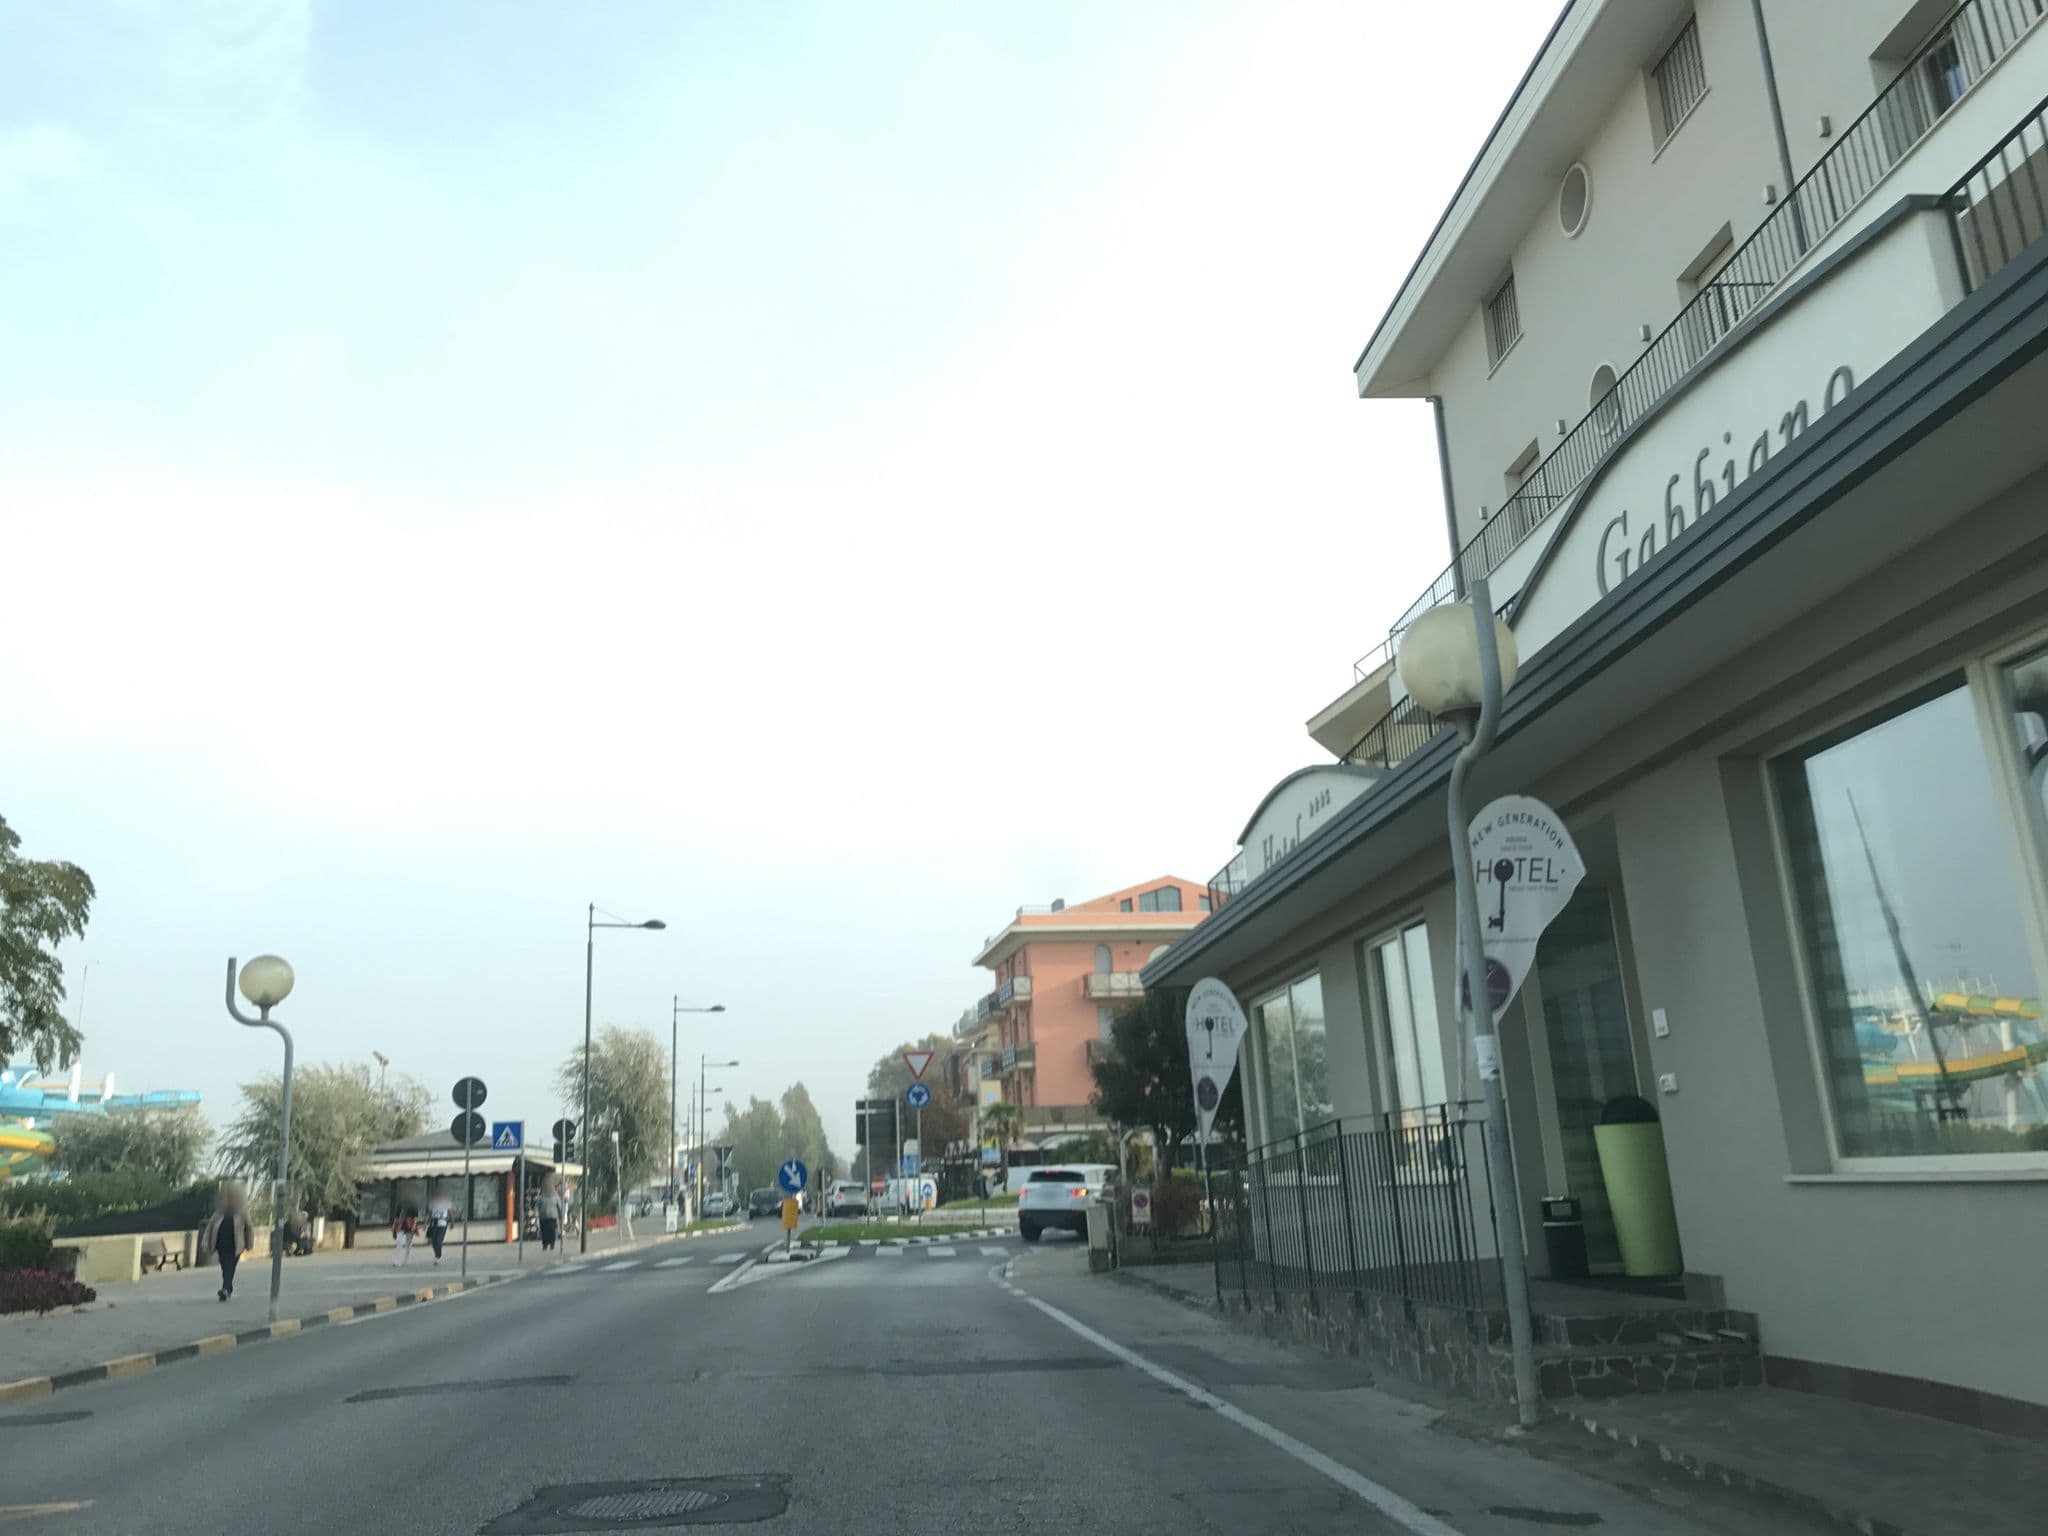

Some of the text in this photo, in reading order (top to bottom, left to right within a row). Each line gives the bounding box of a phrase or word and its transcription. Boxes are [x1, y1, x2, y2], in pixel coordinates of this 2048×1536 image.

[1596, 365, 1855, 600] Gabbiano
[1472, 812, 1564, 849] NEW GENERATION
[1476, 857, 1559, 884] HOTEL
[1195, 1015, 1235, 1033] HOTEL
